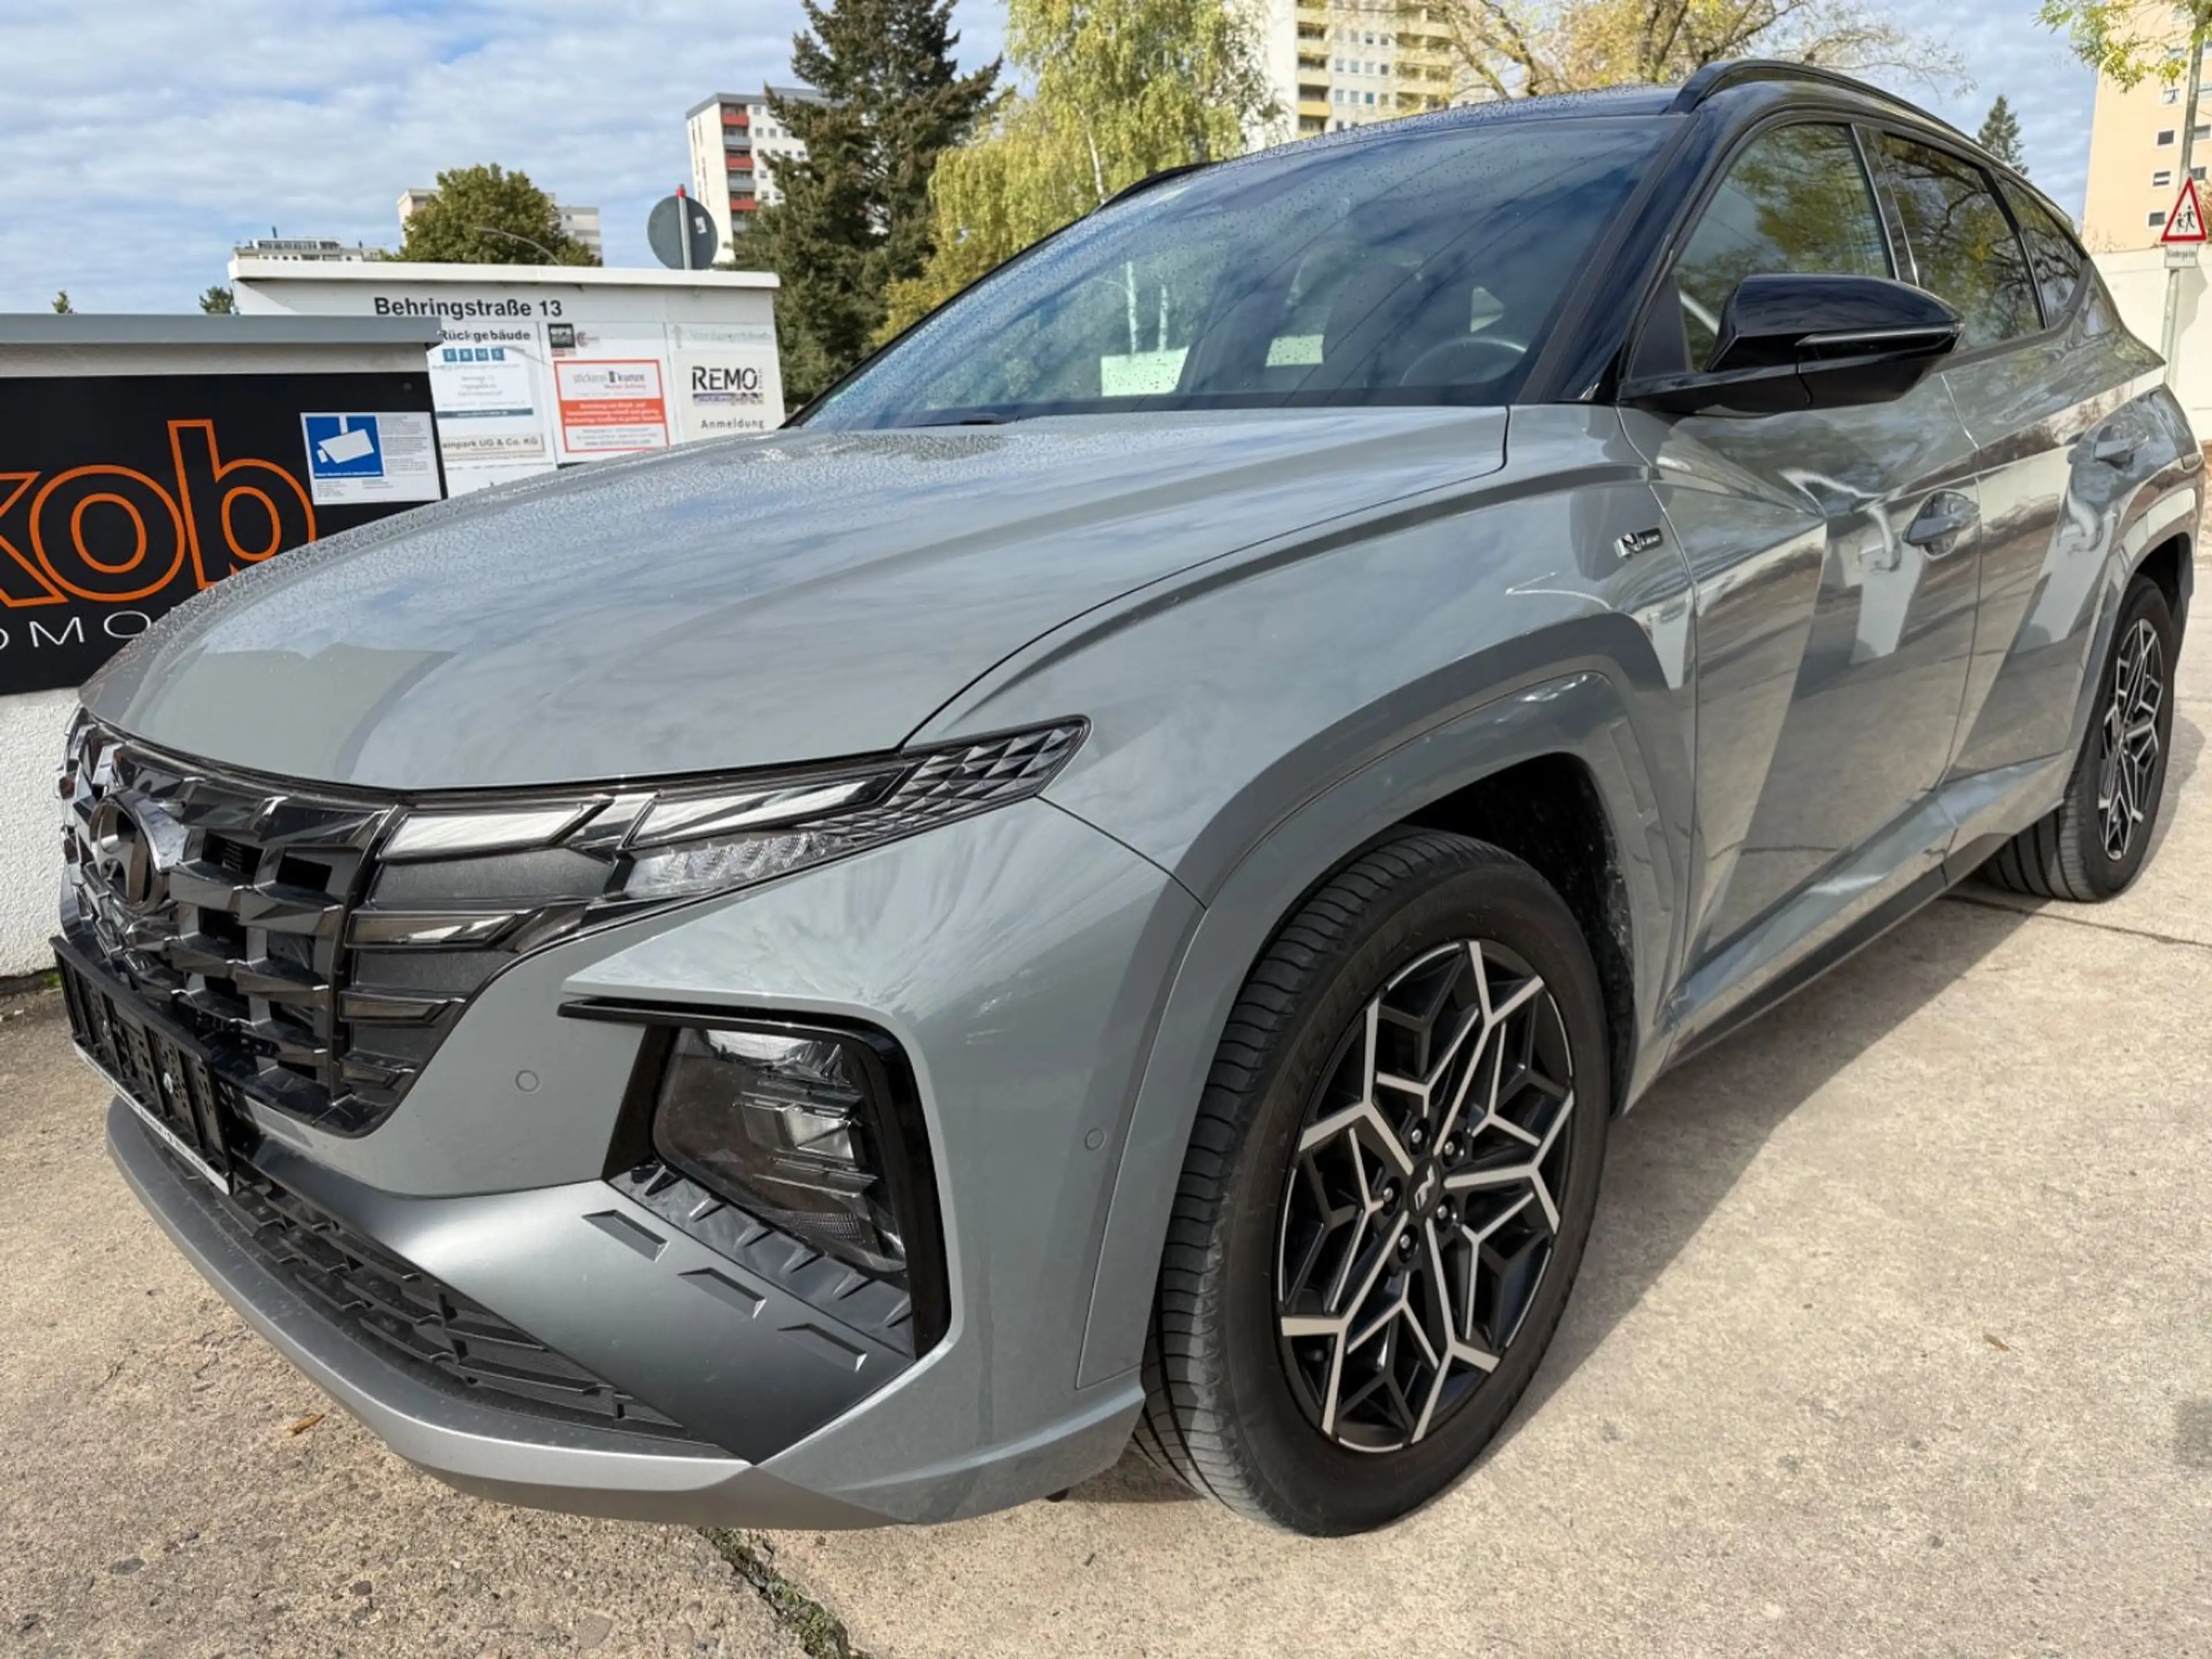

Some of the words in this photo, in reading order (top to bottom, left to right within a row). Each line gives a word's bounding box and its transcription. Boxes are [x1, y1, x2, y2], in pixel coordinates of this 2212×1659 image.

[374, 297, 532, 320] Behringstraße
[539, 300, 563, 317] 13
[441, 329, 531, 343] Rückgebäude
[692, 366, 757, 391] REMO
[700, 418, 765, 430] Anmeldung
